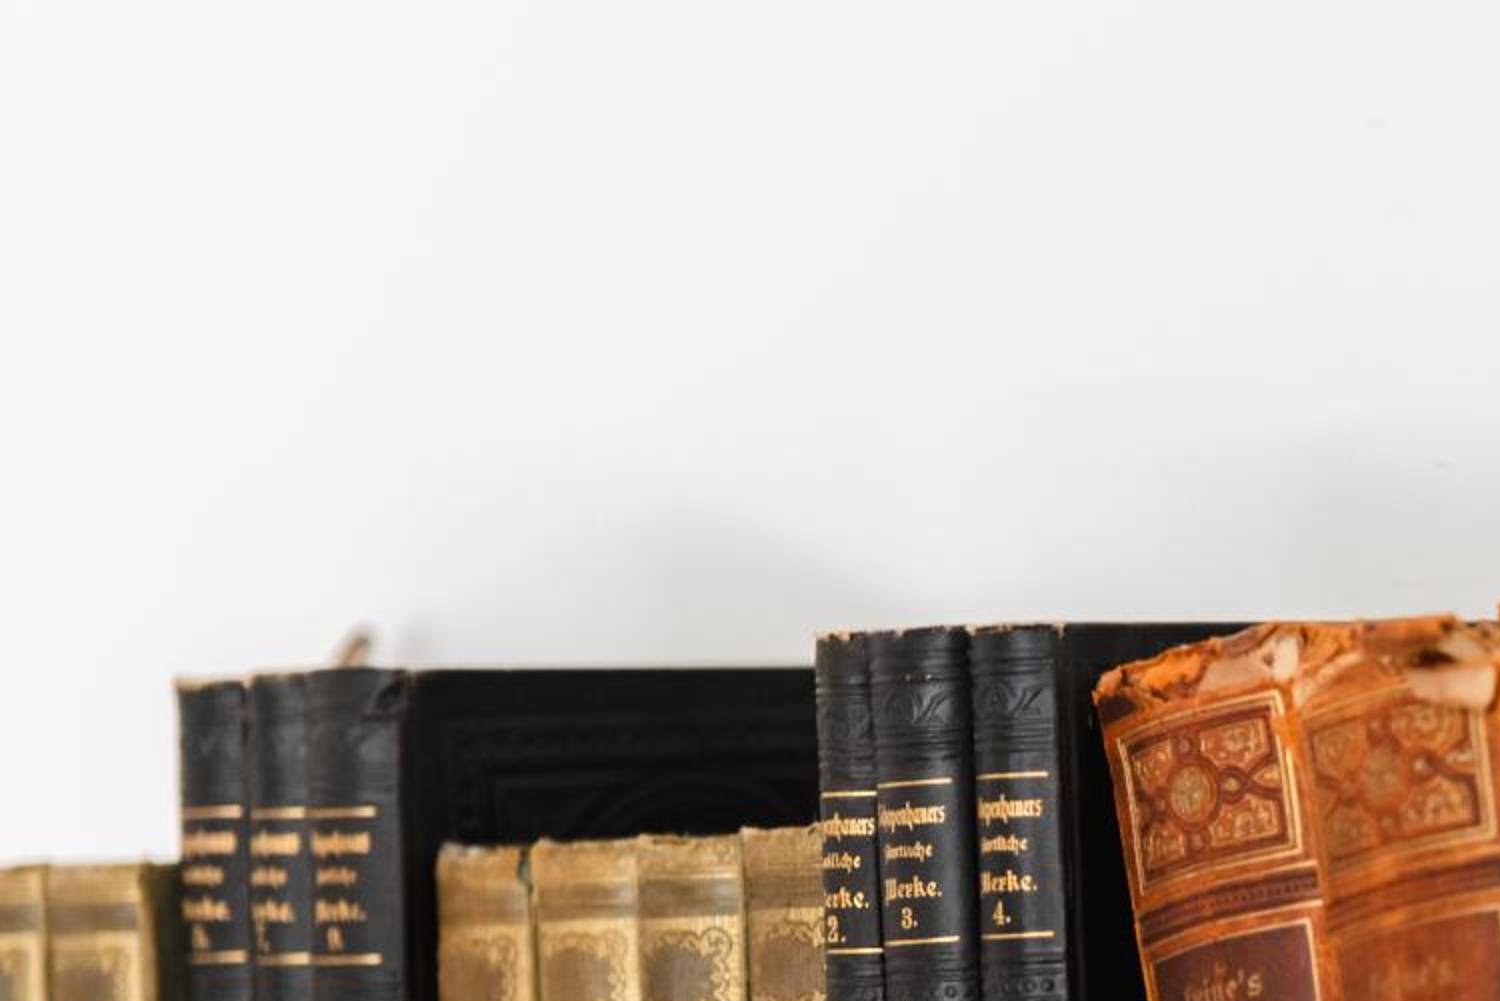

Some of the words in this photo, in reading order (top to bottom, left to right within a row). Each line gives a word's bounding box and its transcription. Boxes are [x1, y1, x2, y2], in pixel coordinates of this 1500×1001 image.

[823, 886, 869, 909] erke.
[827, 914, 847, 943] 2.
[901, 906, 919, 929] 3.
